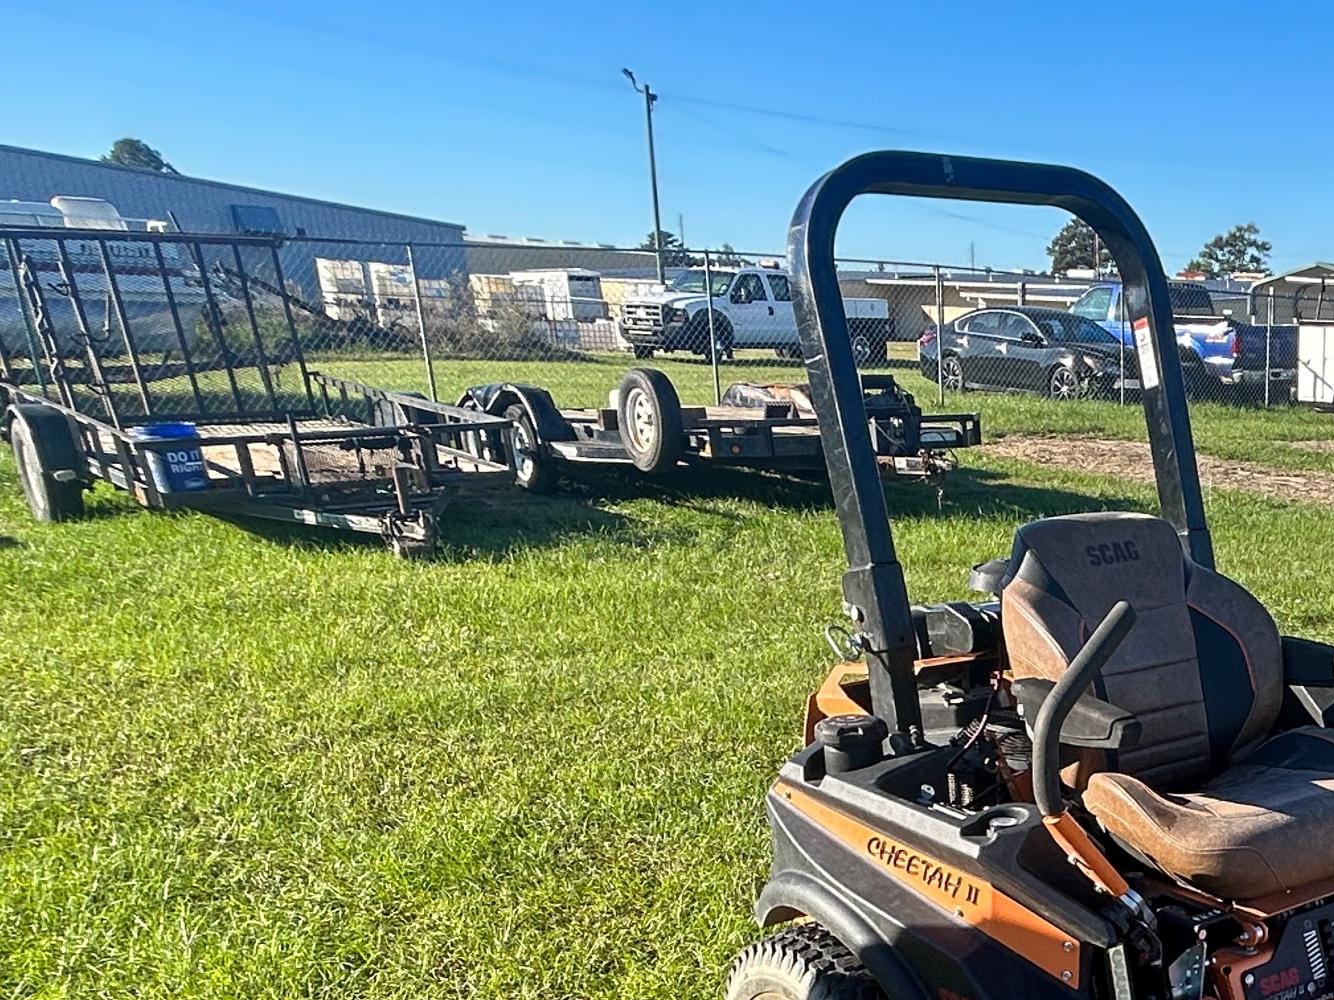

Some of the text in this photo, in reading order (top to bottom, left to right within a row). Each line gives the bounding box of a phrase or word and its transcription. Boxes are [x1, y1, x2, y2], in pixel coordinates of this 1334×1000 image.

[166, 450, 188, 463] DO
[1085, 540, 1140, 567] SCAG
[866, 836, 981, 906] CHEETAH II
[1260, 966, 1300, 997] SCAG
